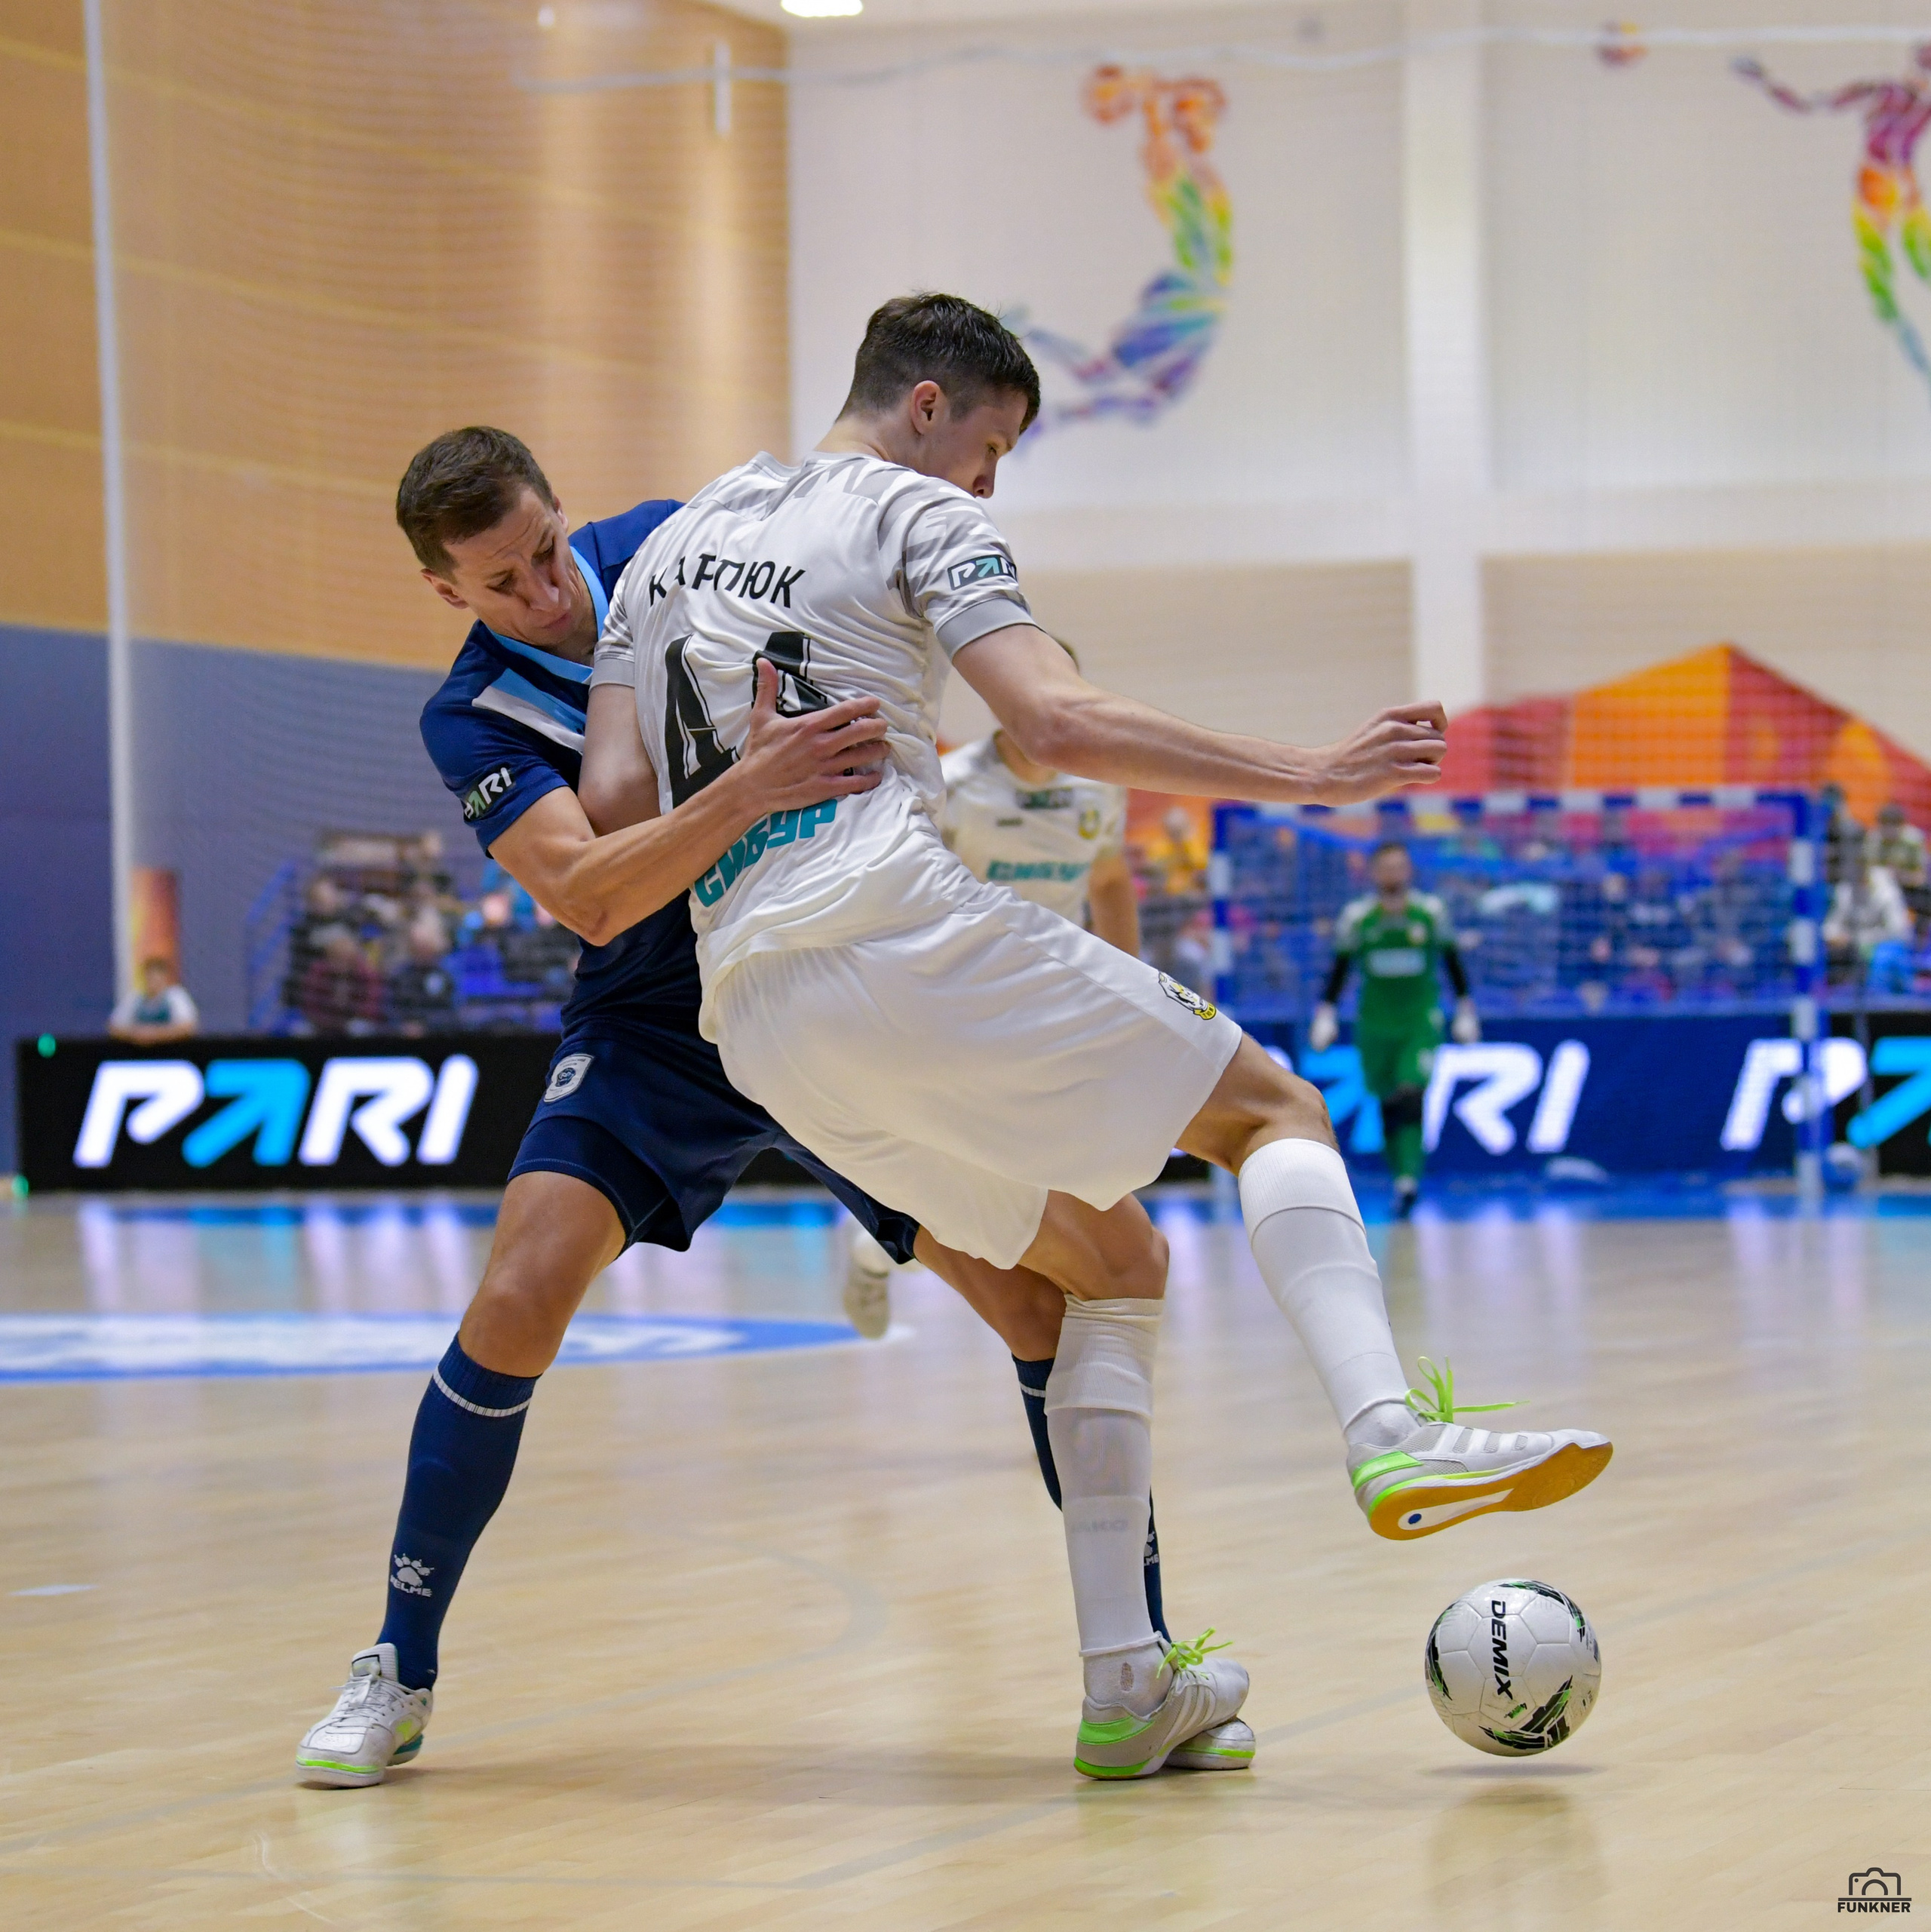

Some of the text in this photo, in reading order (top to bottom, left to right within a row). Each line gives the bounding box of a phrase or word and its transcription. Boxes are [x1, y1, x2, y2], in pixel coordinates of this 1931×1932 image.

[951, 557, 1016, 588] PAR
[72, 1055, 480, 1168] PARI
[1267, 1039, 1590, 1156] ARI
[1490, 1599, 1514, 1700] DEMIX
